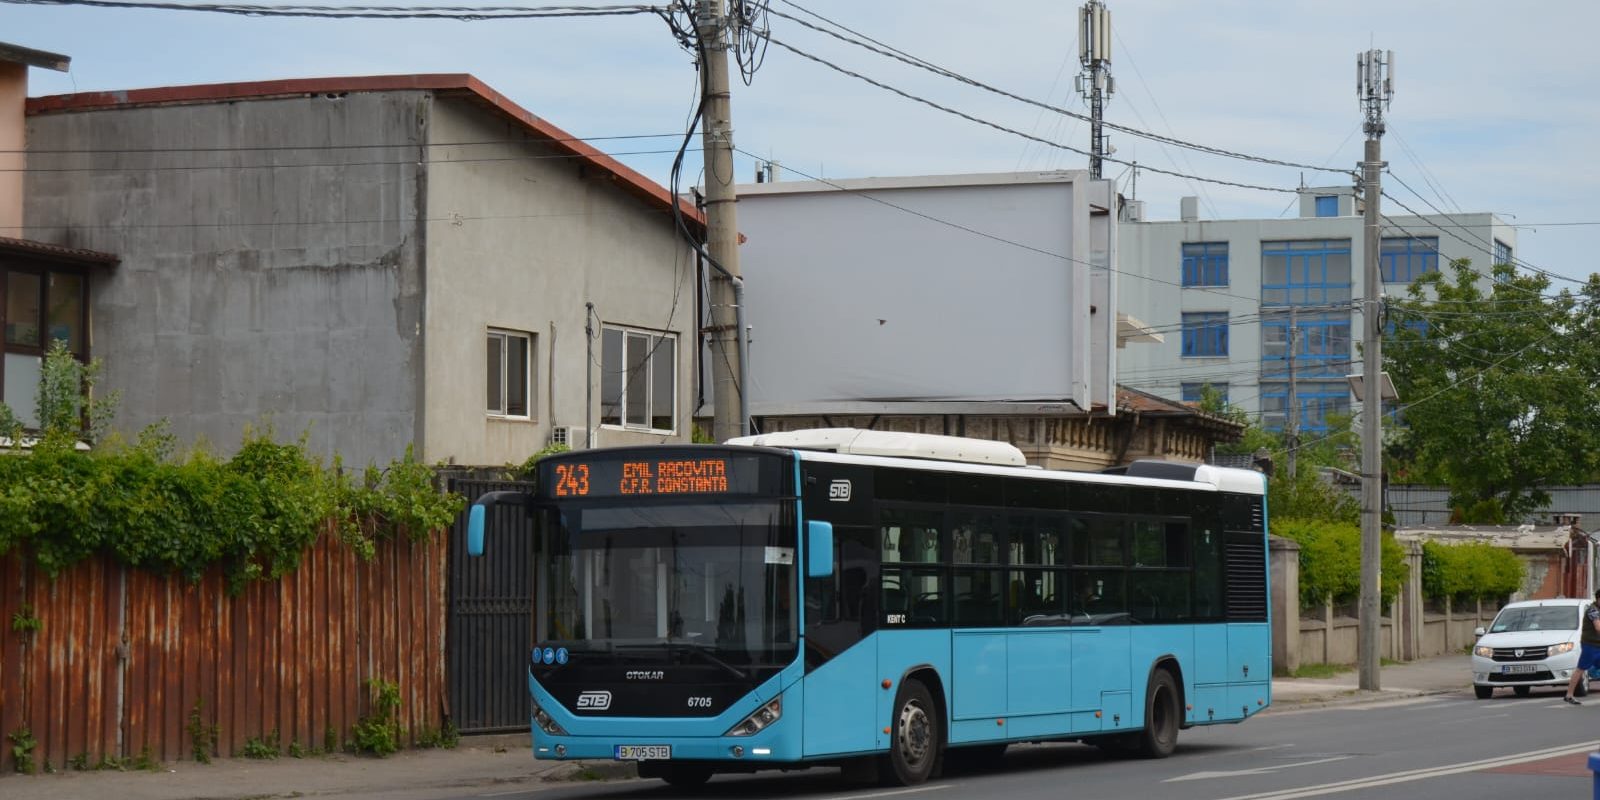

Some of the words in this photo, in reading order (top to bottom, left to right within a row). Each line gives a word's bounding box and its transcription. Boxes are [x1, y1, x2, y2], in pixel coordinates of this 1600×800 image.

[623, 462, 653, 478] EMIL
[658, 460, 725, 477] RACOVITA
[555, 464, 590, 497] 243
[620, 478, 653, 494] C.F.R.
[657, 476, 727, 493] CONSTANTA
[829, 482, 850, 499] STB
[887, 614, 901, 624] KENT
[901, 614, 906, 624] C
[626, 671, 664, 680] OTOKAR
[577, 693, 610, 708] STB
[687, 697, 712, 707] 6705
[621, 746, 627, 758] B
[630, 746, 648, 758] 705
[648, 746, 668, 758] STB
